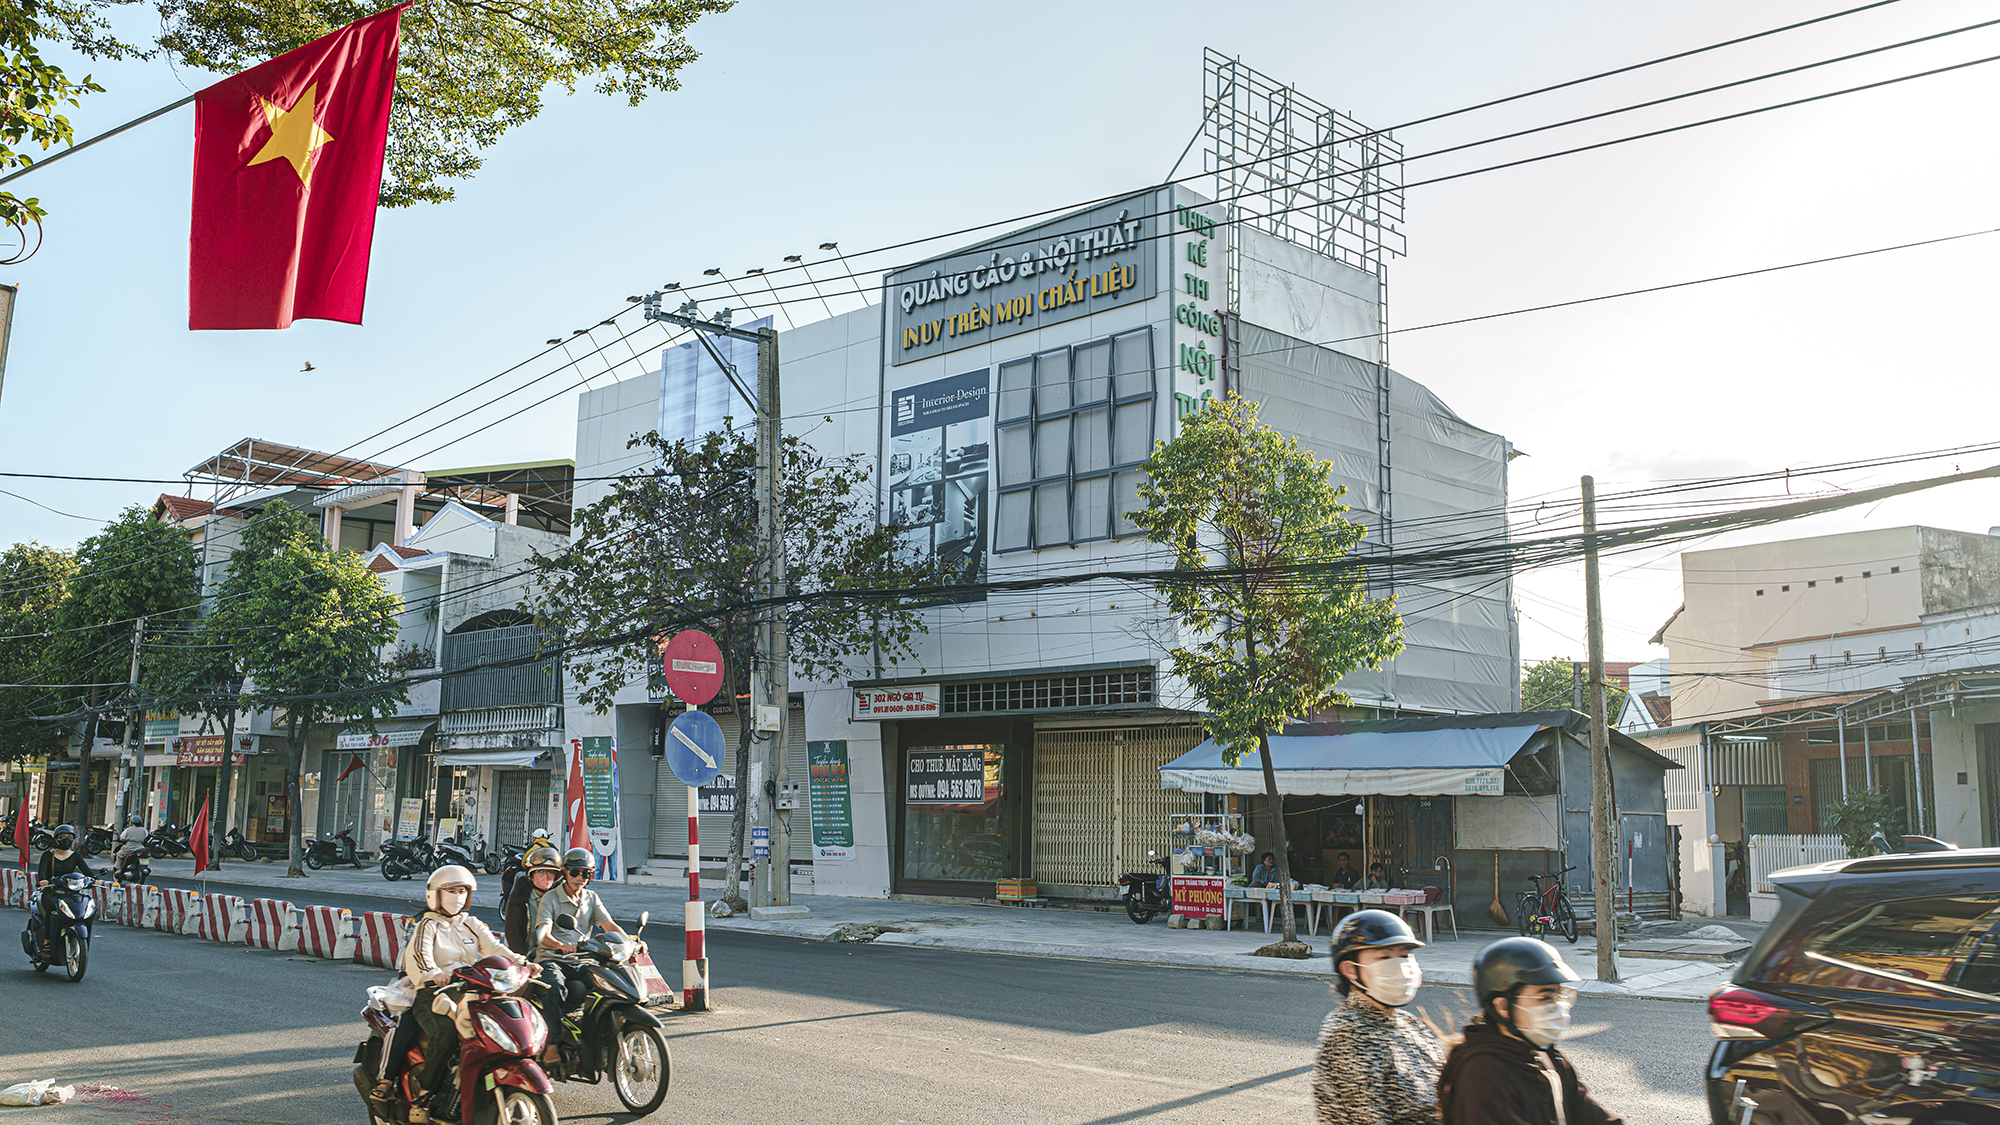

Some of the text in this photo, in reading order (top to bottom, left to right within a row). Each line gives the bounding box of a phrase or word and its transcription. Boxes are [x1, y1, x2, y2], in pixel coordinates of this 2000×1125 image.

[901, 209, 1141, 314] QUẢNG CÁO & NỘI THẤT
[1185, 272, 1209, 301] THI
[947, 302, 993, 338] TRÊN
[996, 293, 1034, 325] MỌI
[1038, 269, 1089, 311] CHẤT
[1091, 261, 1137, 299] LIỆU
[1177, 301, 1220, 337] CÔNG
[1181, 340, 1216, 385] NỘI
[922, 386, 986, 409] Interior Design
[874, 694, 886, 703] 302
[887, 691, 901, 702] NGÔ
[903, 692, 914, 701] GIA
[367, 735, 389, 747] 306
[910, 758, 925, 773] CHO
[925, 755, 944, 773] THUÊ
[945, 754, 961, 775] MẶT
[62, 776, 94, 784] TRUG
[937, 779, 949, 799] 094
[951, 779, 963, 799] 563
[964, 779, 982, 799] 9678
[710, 794, 720, 811] 094
[720, 794, 729, 811] 563
[401, 811, 419, 822] 306
[1189, 888, 1223, 906] PHƯỢNG
